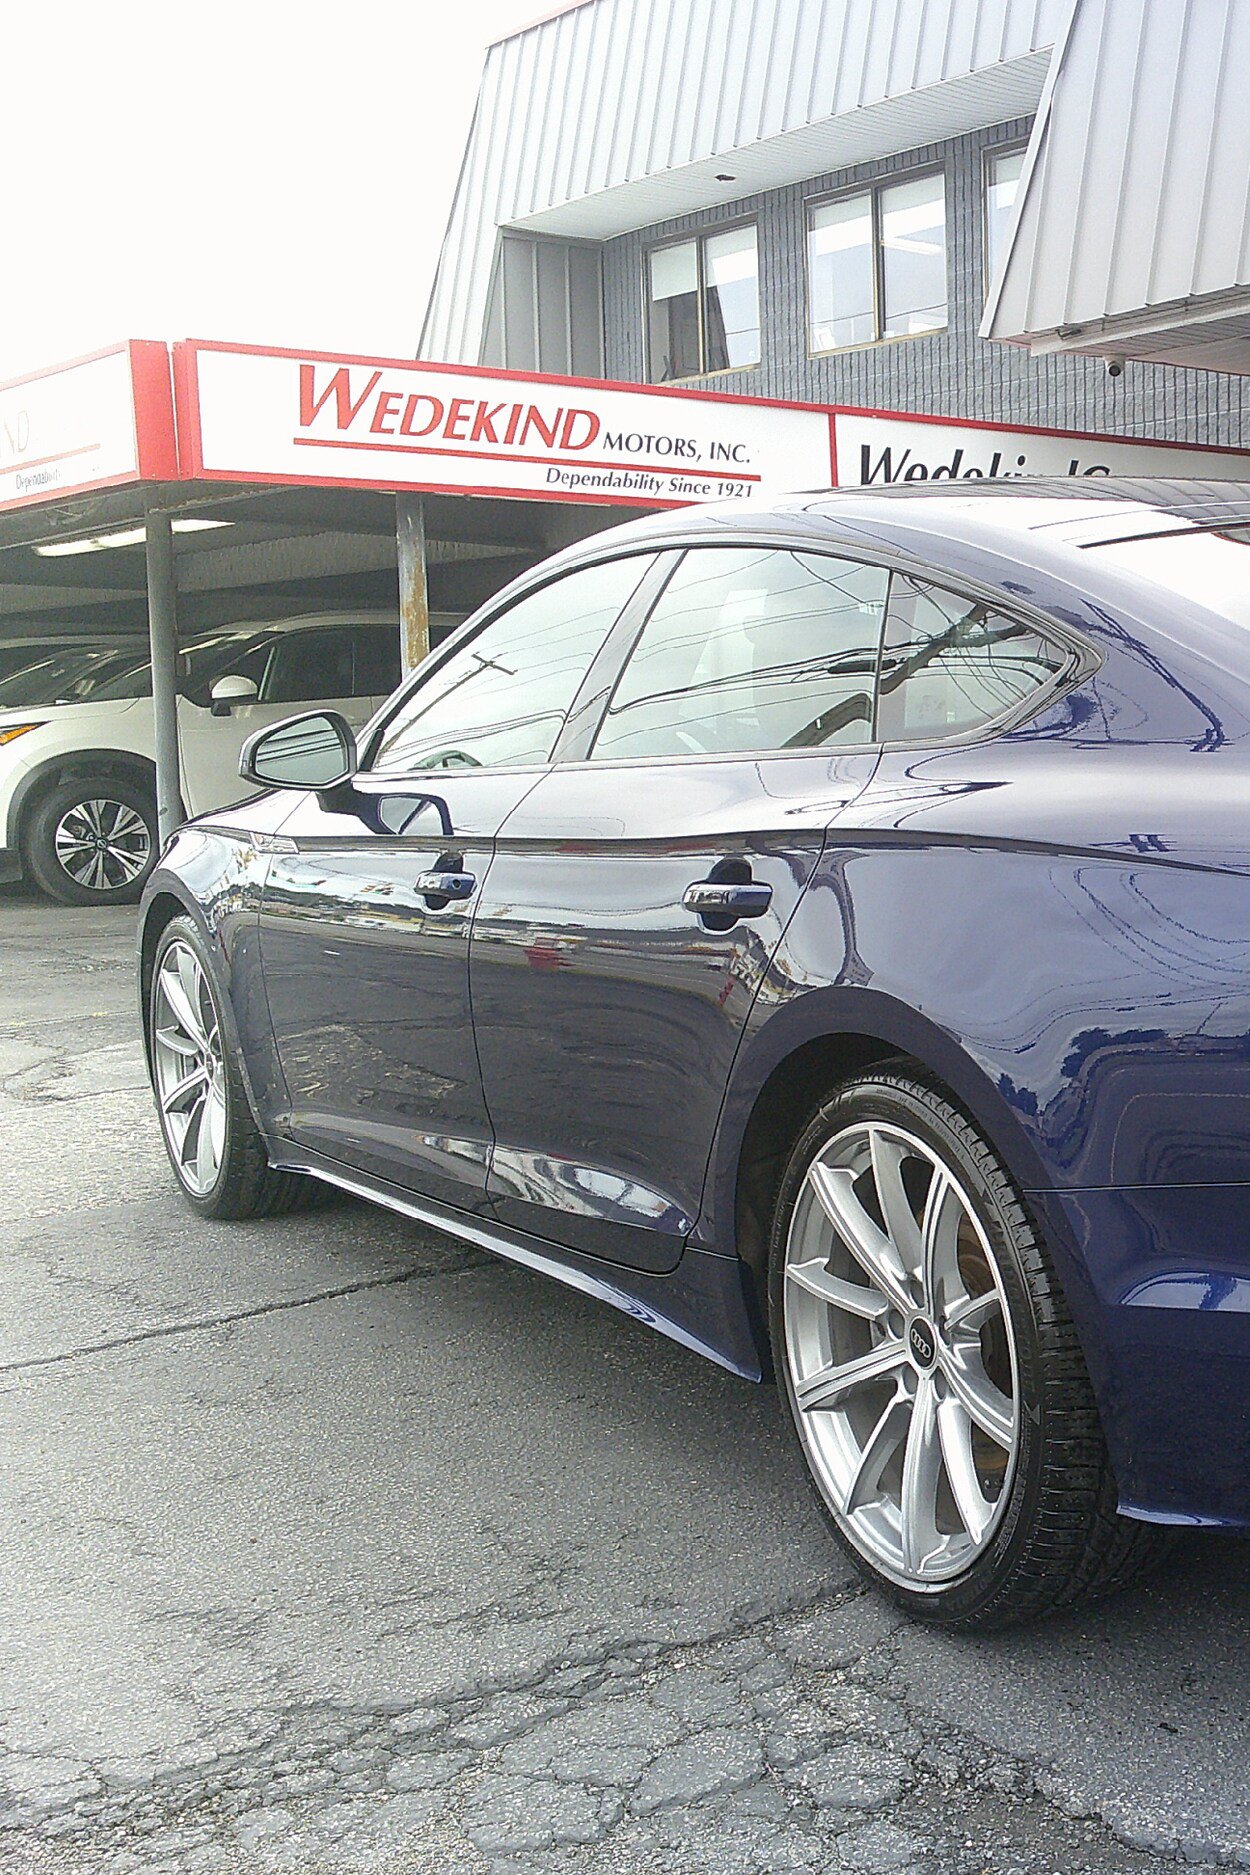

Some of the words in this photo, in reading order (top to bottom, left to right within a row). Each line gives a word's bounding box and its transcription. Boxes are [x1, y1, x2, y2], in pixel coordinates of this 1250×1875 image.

[602, 432, 702, 462] MOTORS,
[709, 441, 751, 463] INC.
[546, 467, 665, 495] Dependability
[668, 477, 711, 495] Since
[717, 482, 753, 498] 1921
